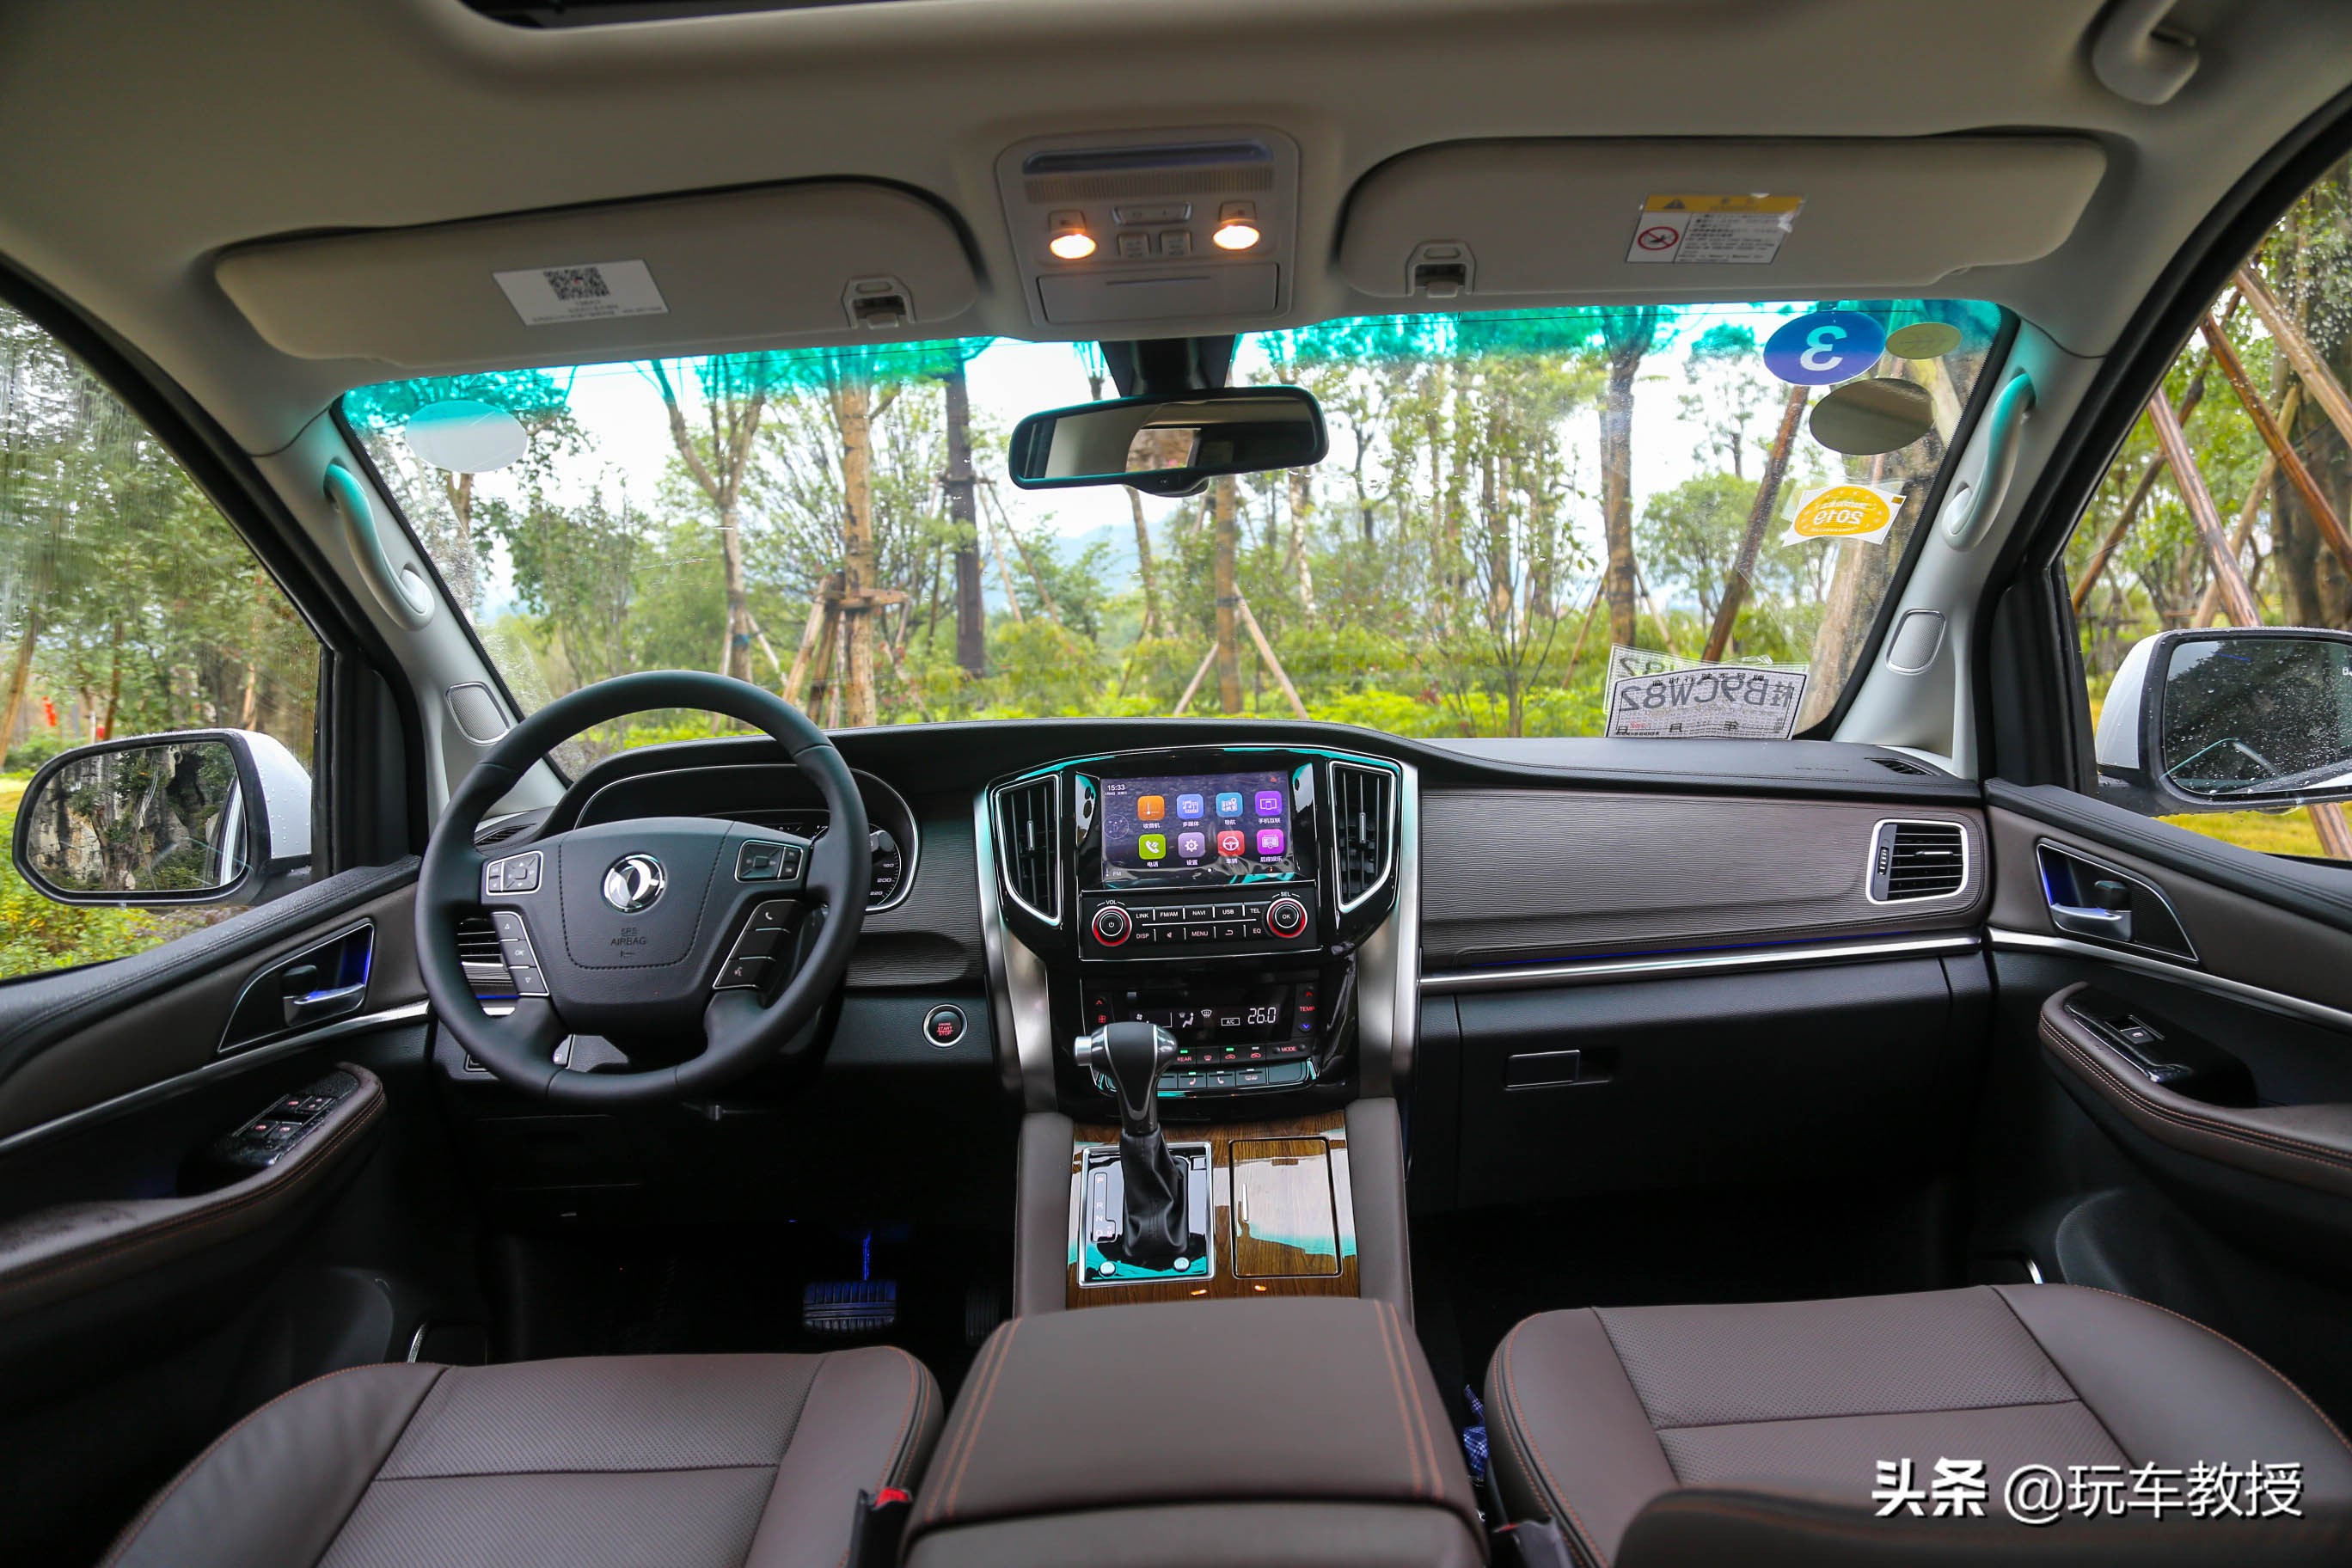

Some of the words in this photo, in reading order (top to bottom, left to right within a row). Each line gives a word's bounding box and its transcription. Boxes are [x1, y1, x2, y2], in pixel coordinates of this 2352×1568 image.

[610, 937, 646, 946] AIRBAG
[1247, 1007, 1277, 1025] 26.0
[1096, 1202, 1104, 1210] R
